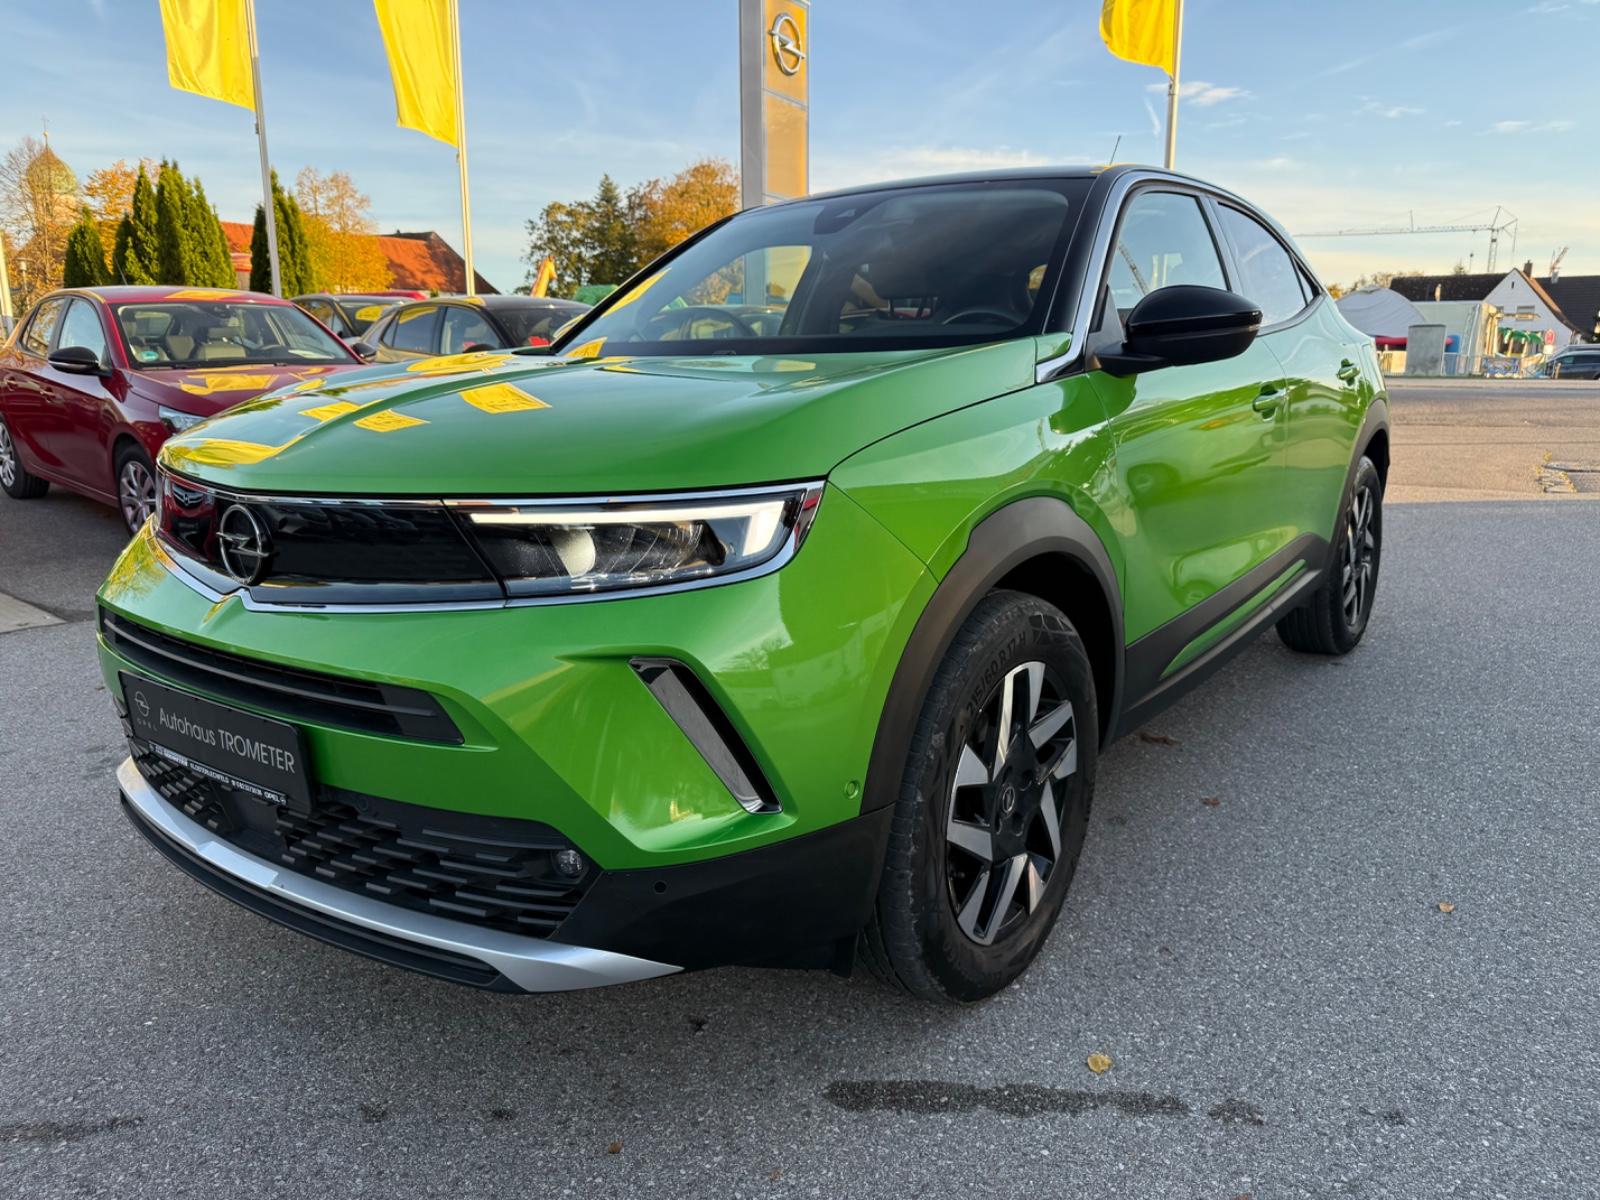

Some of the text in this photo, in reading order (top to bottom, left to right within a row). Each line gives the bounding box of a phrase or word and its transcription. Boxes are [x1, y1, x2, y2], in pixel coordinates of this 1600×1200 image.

[966, 660, 999, 716] 215/60
[160, 707, 216, 746] Autohaus
[218, 729, 295, 774] TROMETER
